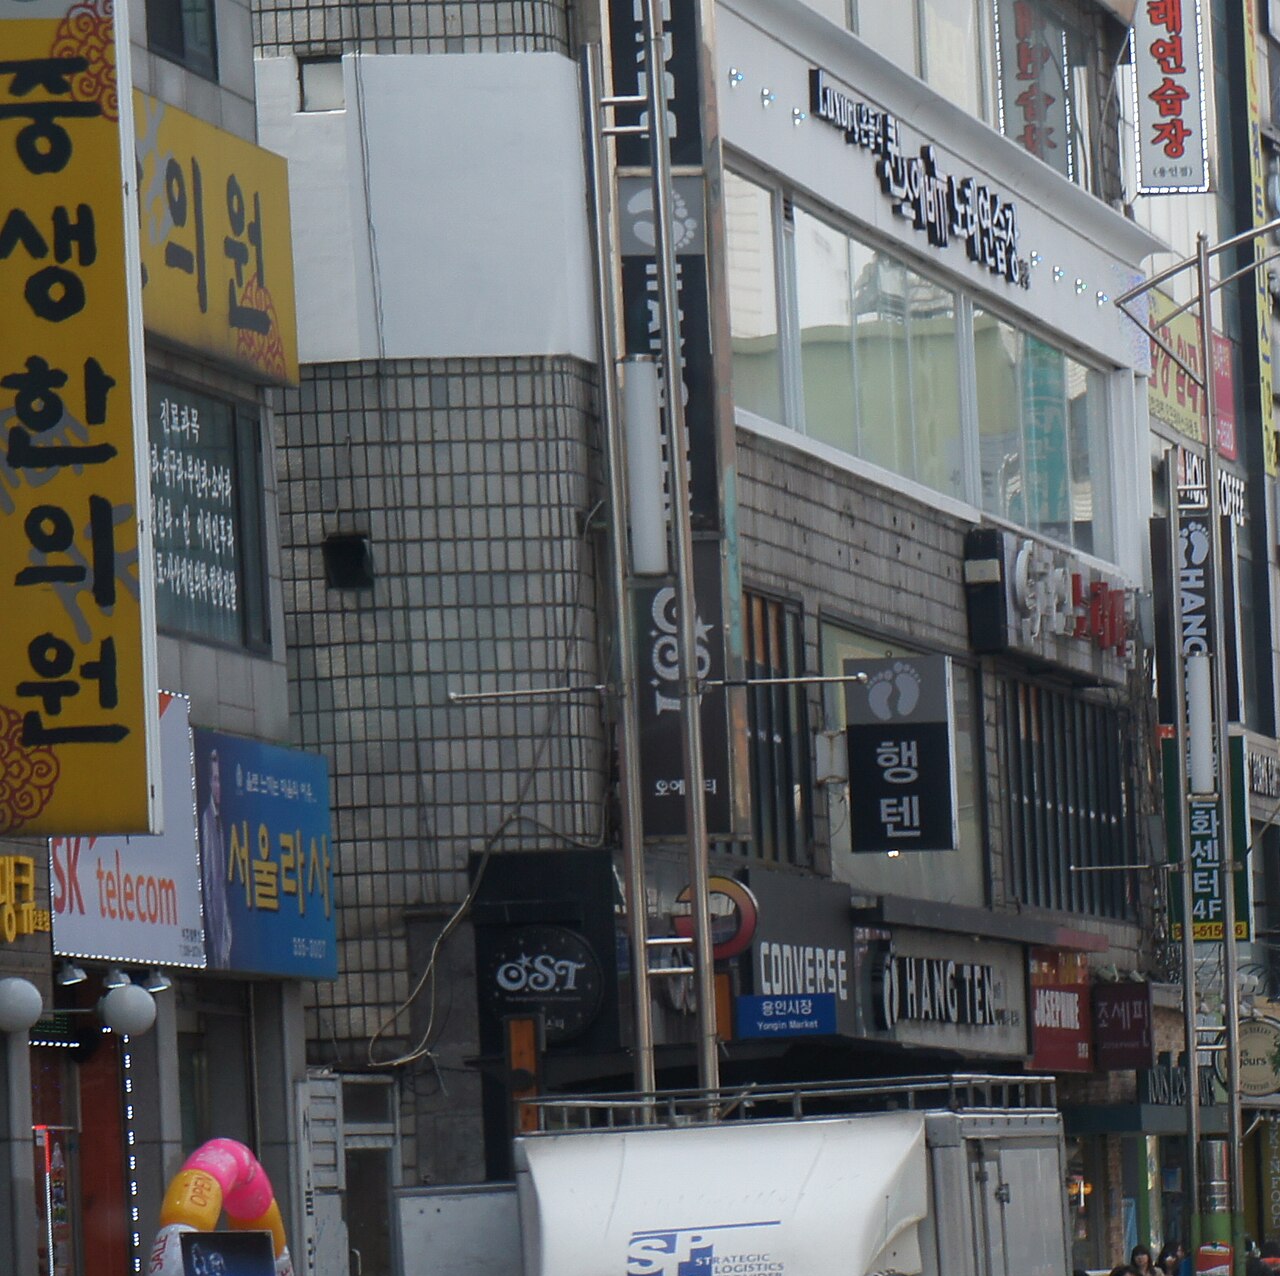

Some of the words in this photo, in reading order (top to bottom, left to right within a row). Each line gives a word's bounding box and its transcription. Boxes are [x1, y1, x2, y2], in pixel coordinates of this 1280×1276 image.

[137, 158, 272, 335] 의원
[655, 779, 716, 796] 오에티
[876, 741, 921, 837] 행텐
[96, 850, 177, 926] telecom
[228, 820, 331, 920] 서울라사
[1192, 900, 1223, 920] 4F
[761, 942, 847, 1000] CONVERSE
[906, 956, 956, 1022] HANG
[963, 963, 996, 1024] TEN
[757, 1020, 787, 1031] Yongin
[789, 1018, 818, 1028] Market
[762, 1000, 812, 1015] 용인시장
[150, 1235, 169, 1274] SALE
[695, 1254, 770, 1267] STRATEGIC
[714, 1263, 784, 1274] LOGISTICS
